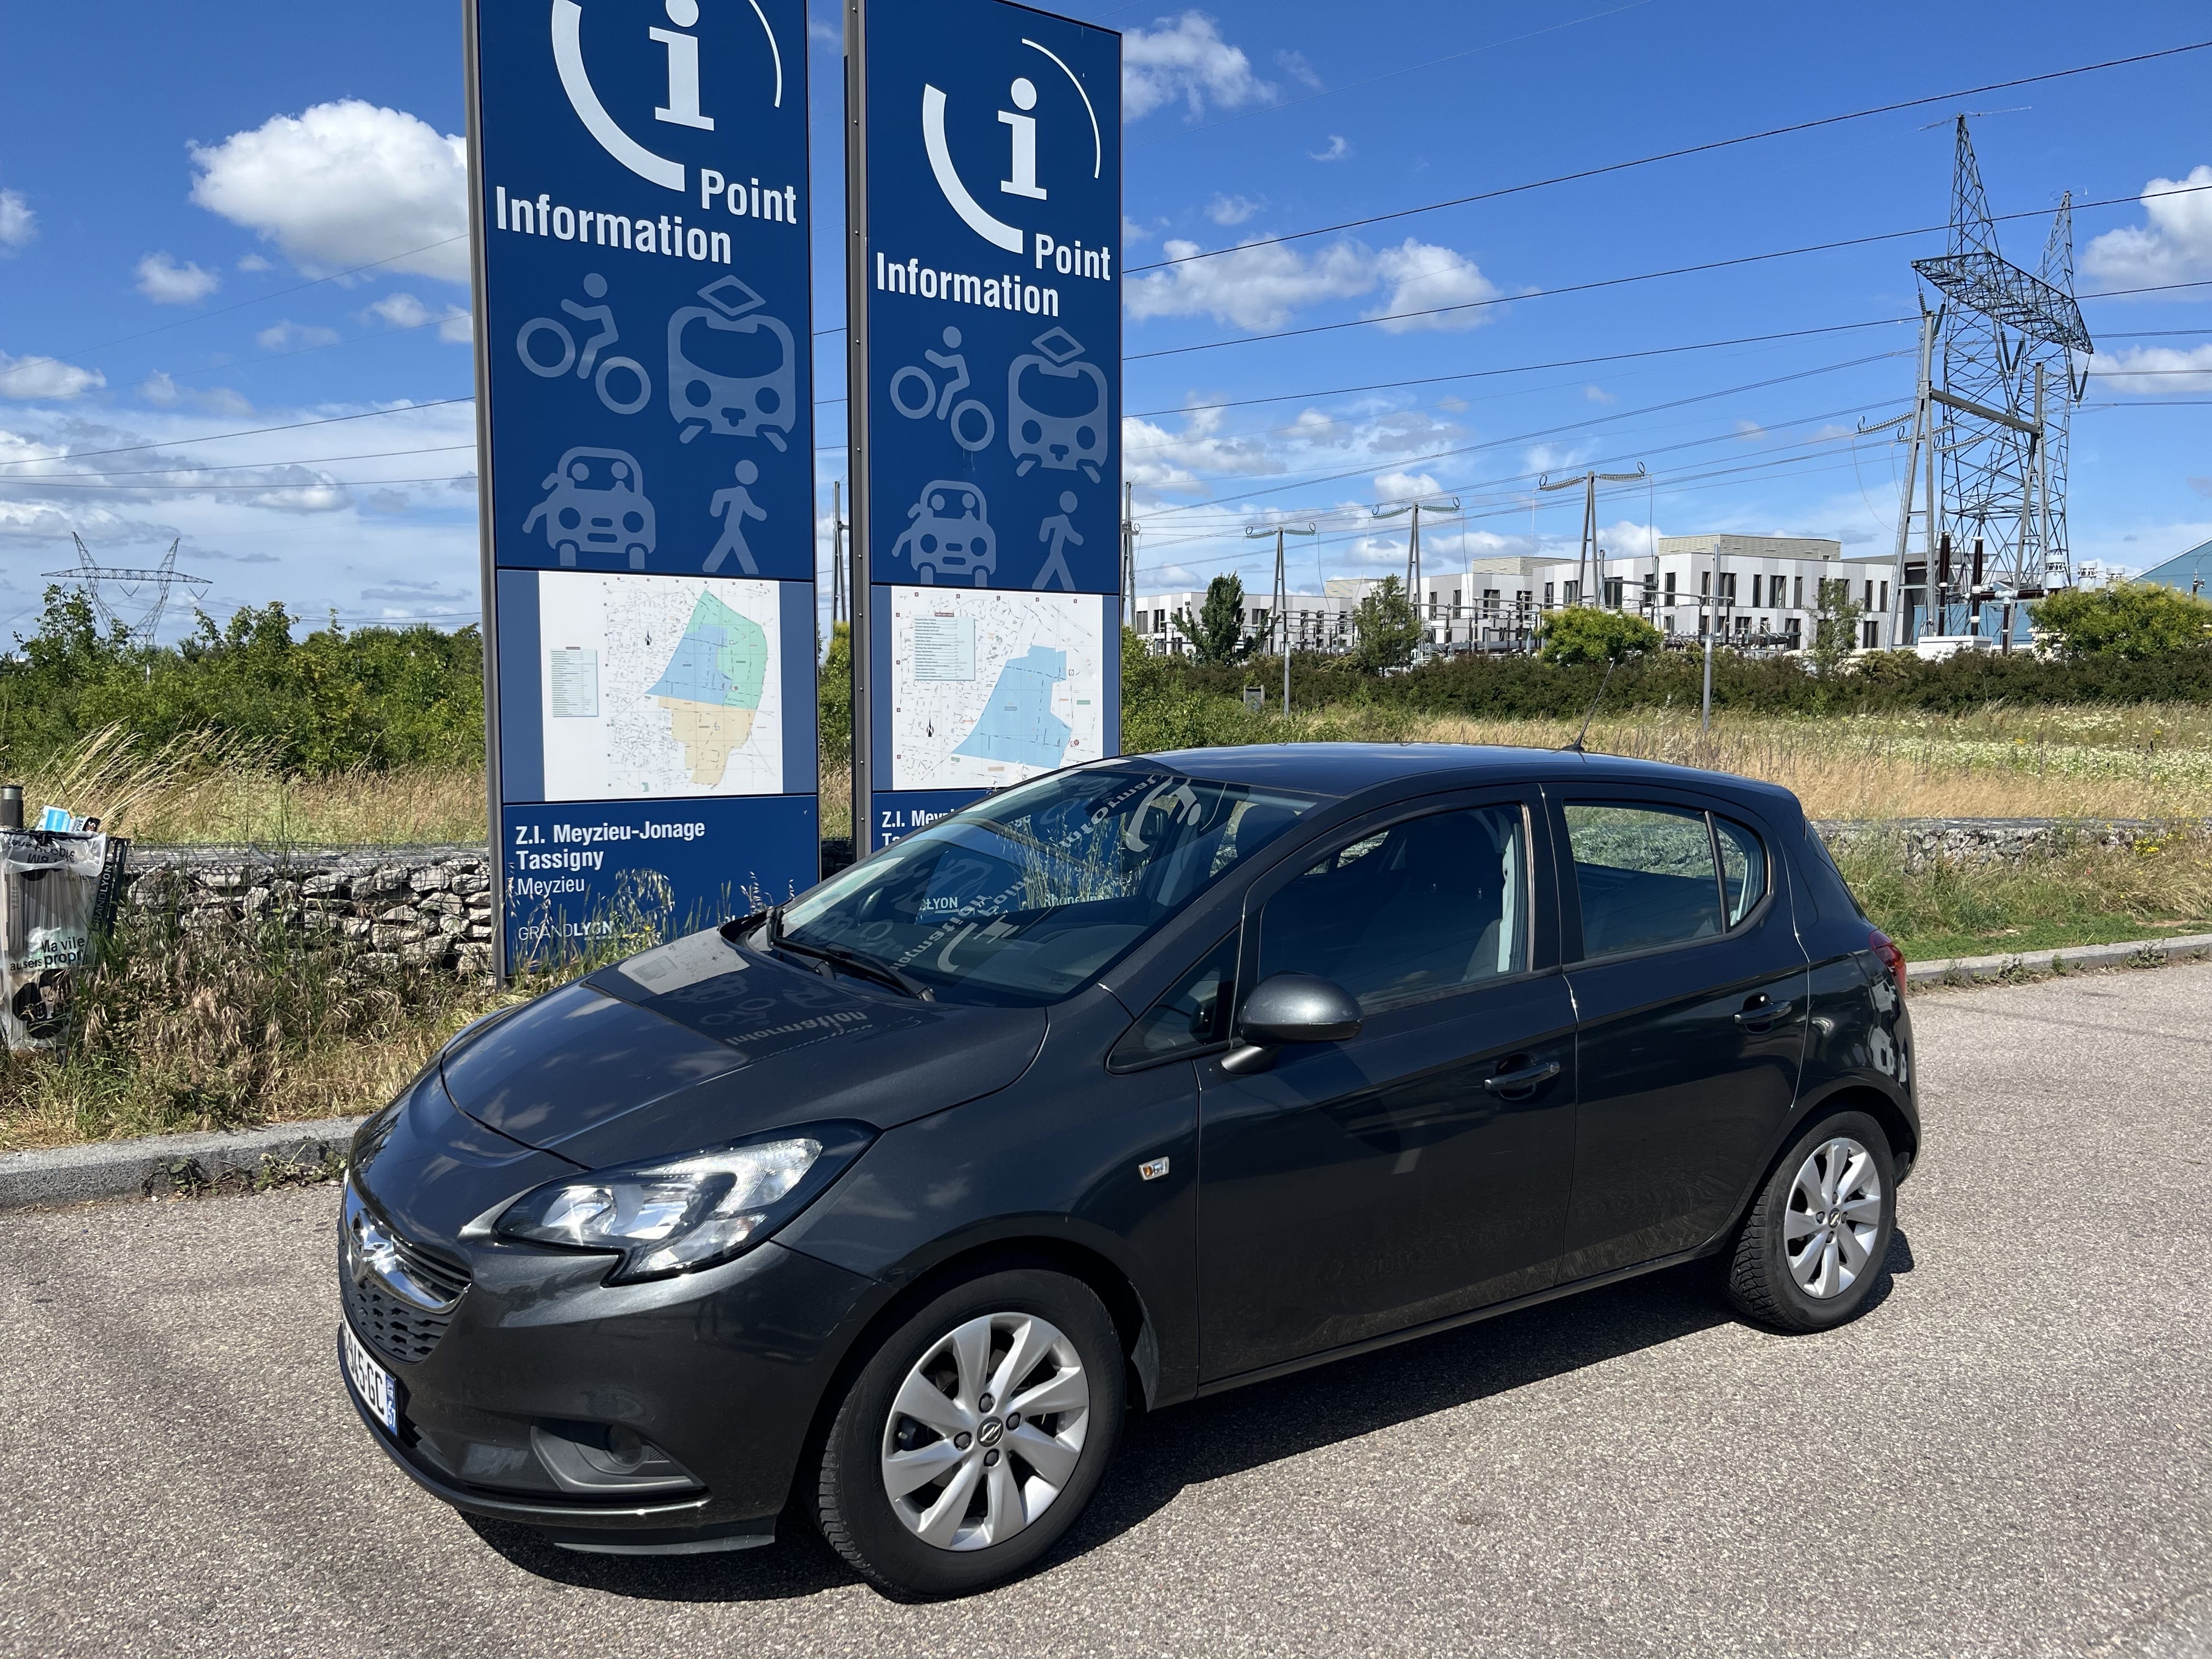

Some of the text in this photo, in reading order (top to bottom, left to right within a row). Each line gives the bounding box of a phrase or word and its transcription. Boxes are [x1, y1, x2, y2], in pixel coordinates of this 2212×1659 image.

[701, 168, 797, 224] Point
[496, 185, 731, 264] Information
[1036, 233, 1110, 281] Point
[877, 252, 1058, 317] Information
[882, 810, 905, 828] Z.I.
[515, 821, 706, 846] Z.I. Meyzieu-Jonage
[516, 849, 604, 871] Tassigny
[517, 876, 585, 895] Meyzieu
[44, 949, 83, 968] propr
